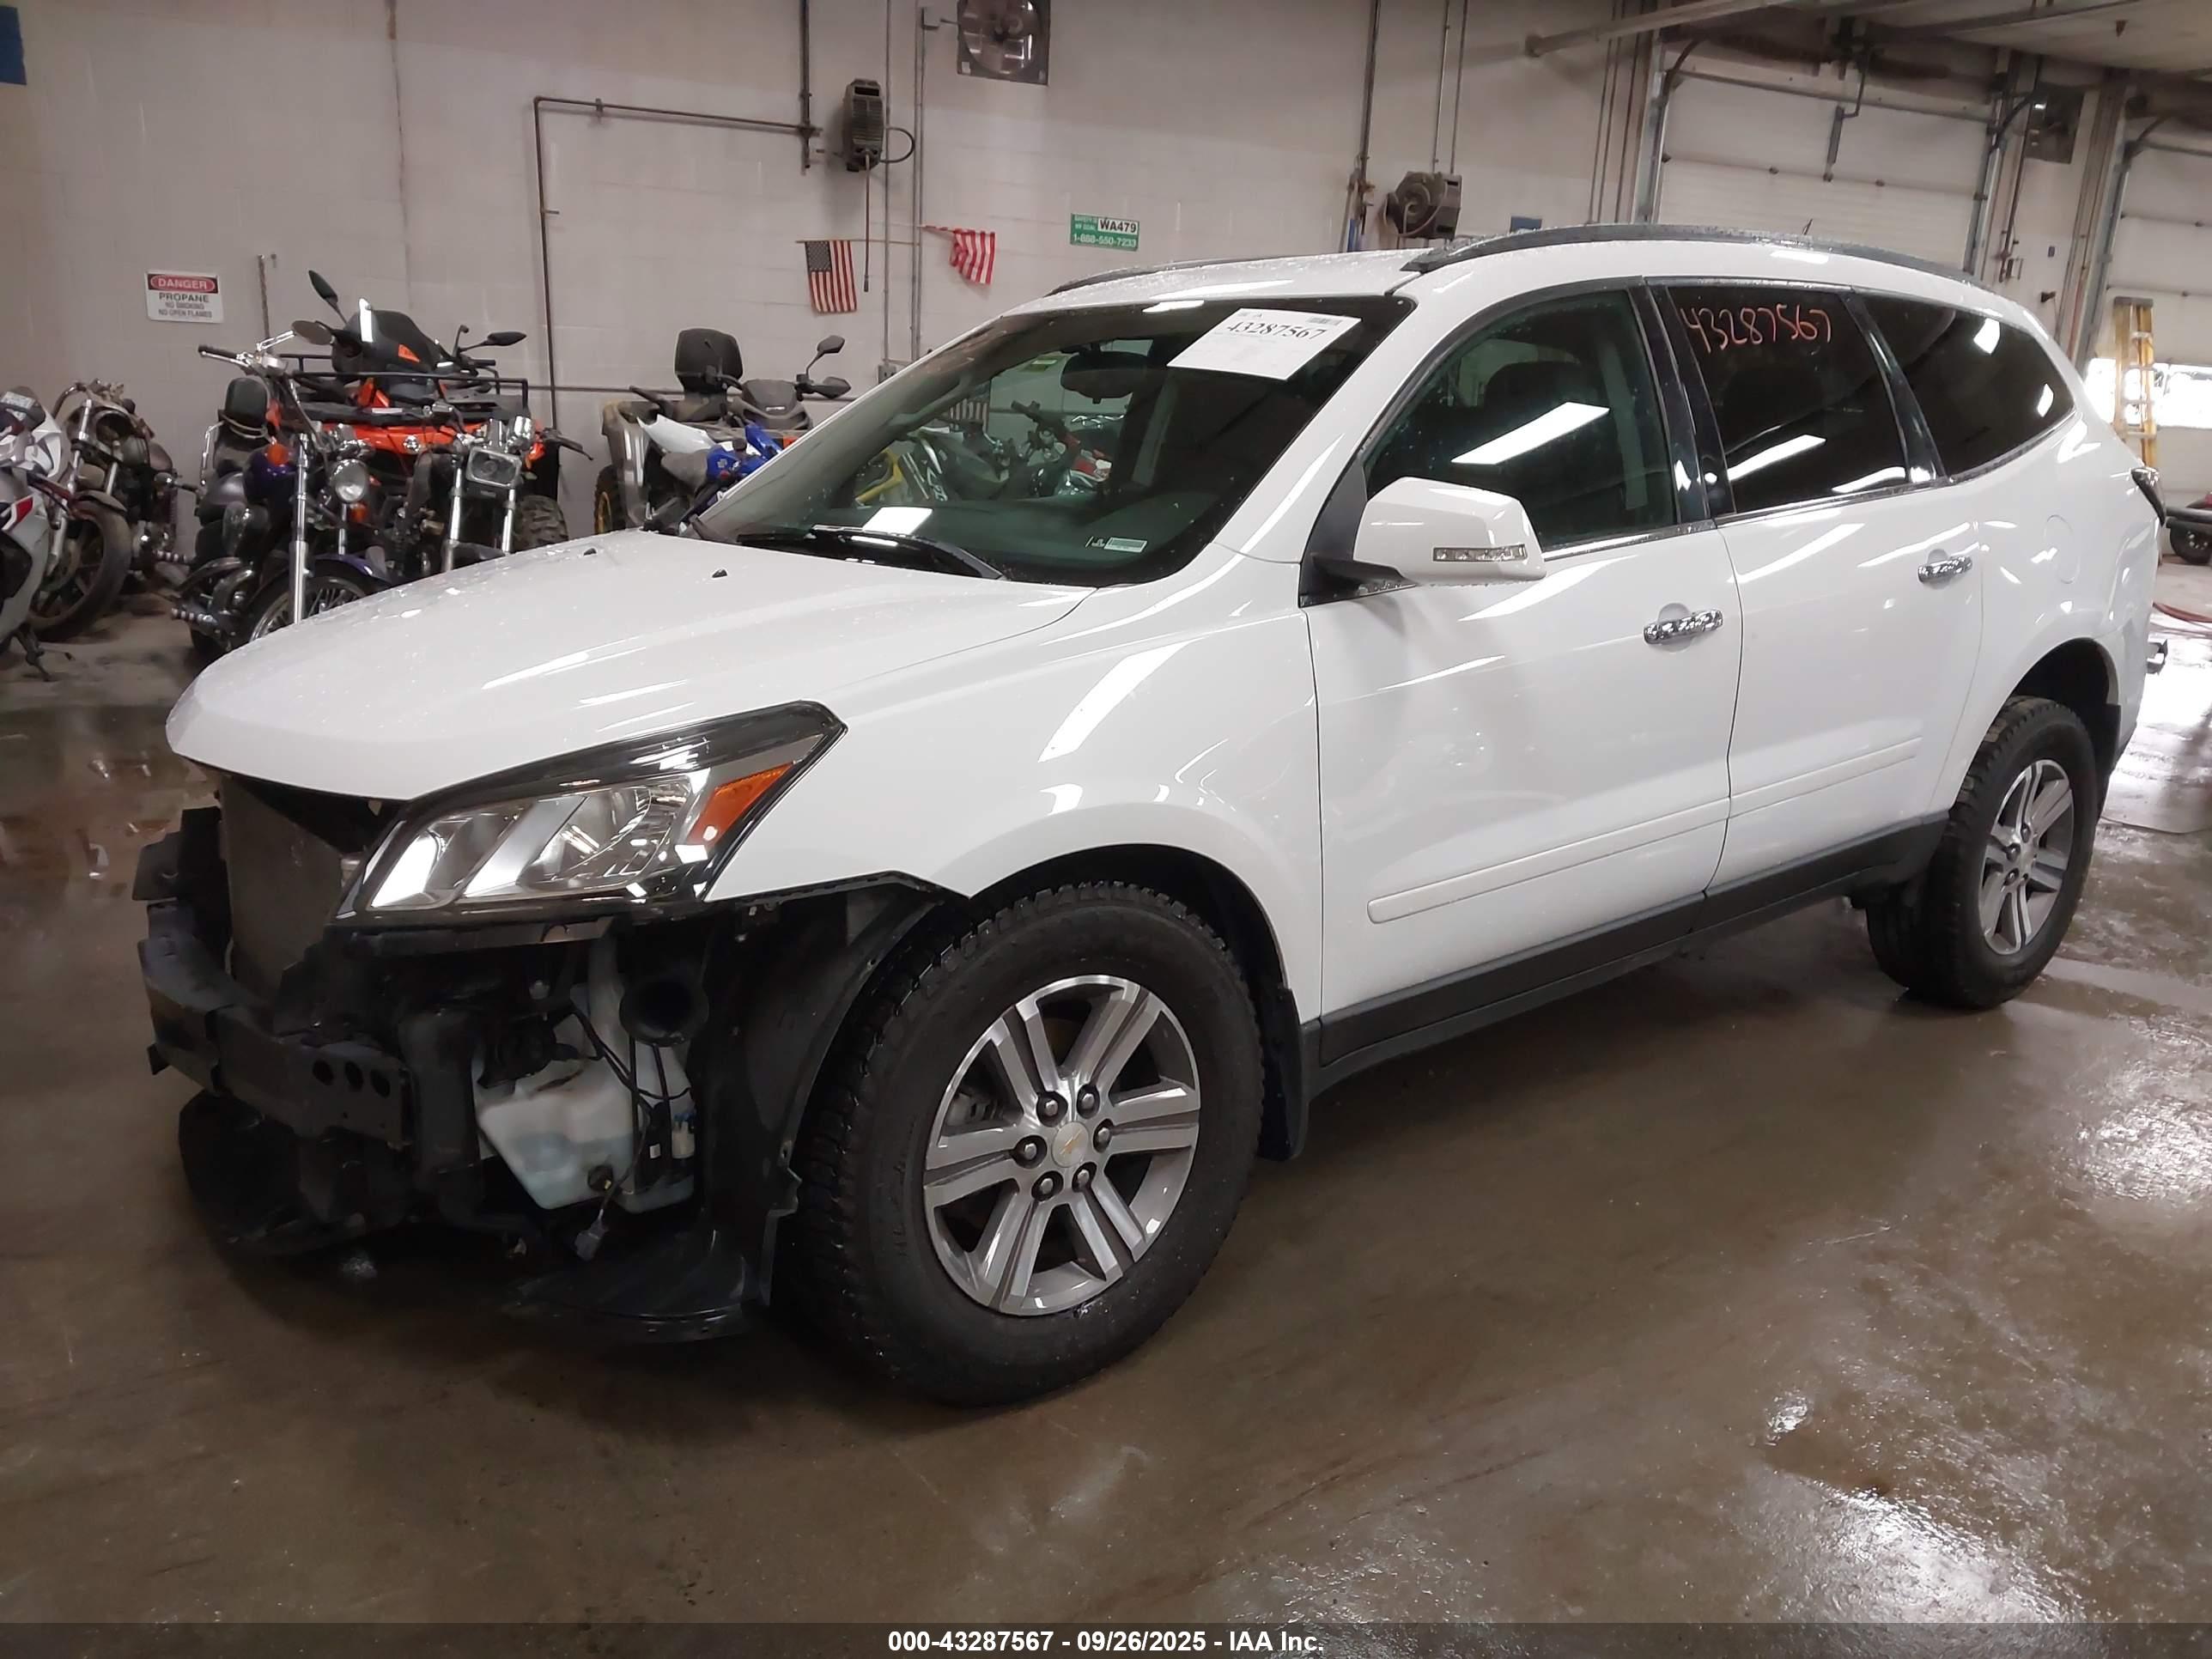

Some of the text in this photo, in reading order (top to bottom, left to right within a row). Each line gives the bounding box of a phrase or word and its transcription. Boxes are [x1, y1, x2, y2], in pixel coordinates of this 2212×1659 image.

[1100, 219, 1136, 233] WA479
[158, 277, 207, 289] DANGER
[159, 292, 210, 303] PROPANE
[1228, 321, 1328, 340] 43287567
[1680, 303, 1832, 354] 43287567
